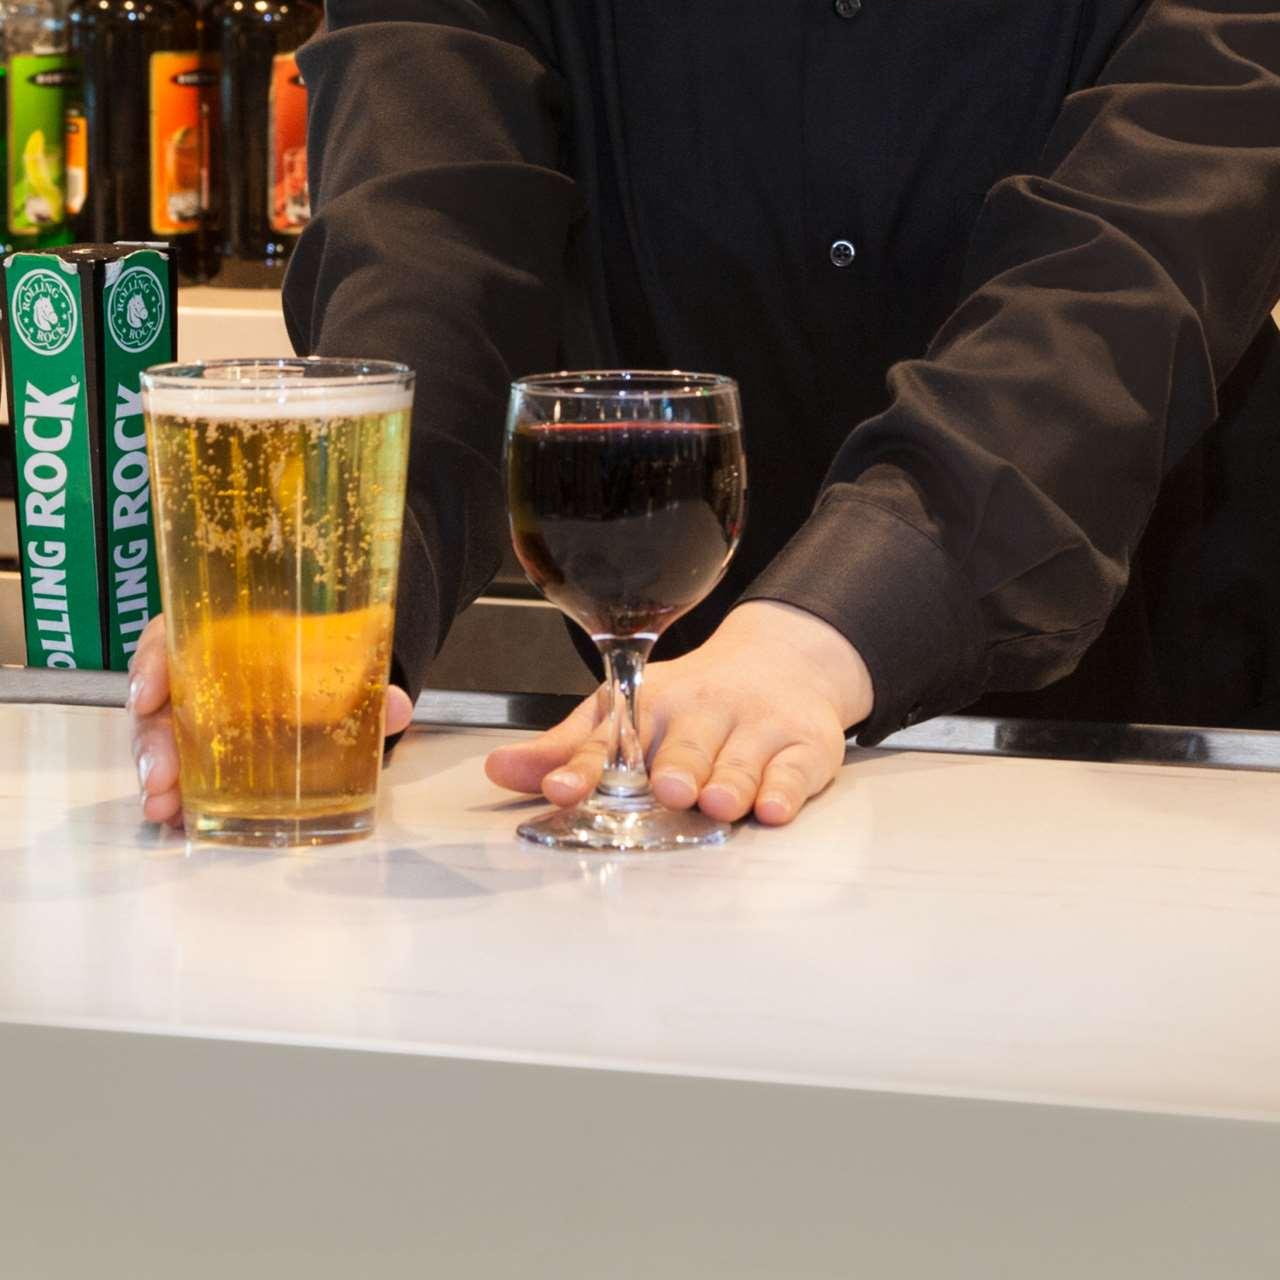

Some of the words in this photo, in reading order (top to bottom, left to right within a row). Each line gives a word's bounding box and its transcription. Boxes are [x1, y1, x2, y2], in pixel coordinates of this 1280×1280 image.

[21, 281, 60, 312] ROLLING
[35, 324, 66, 343] ROCK
[116, 278, 150, 313] ROLLING
[128, 320, 155, 341] ROCK
[23, 379, 80, 529] ROCK
[112, 383, 150, 532] ROCK
[26, 539, 77, 670] OLLING
[113, 538, 150, 667] LLING
